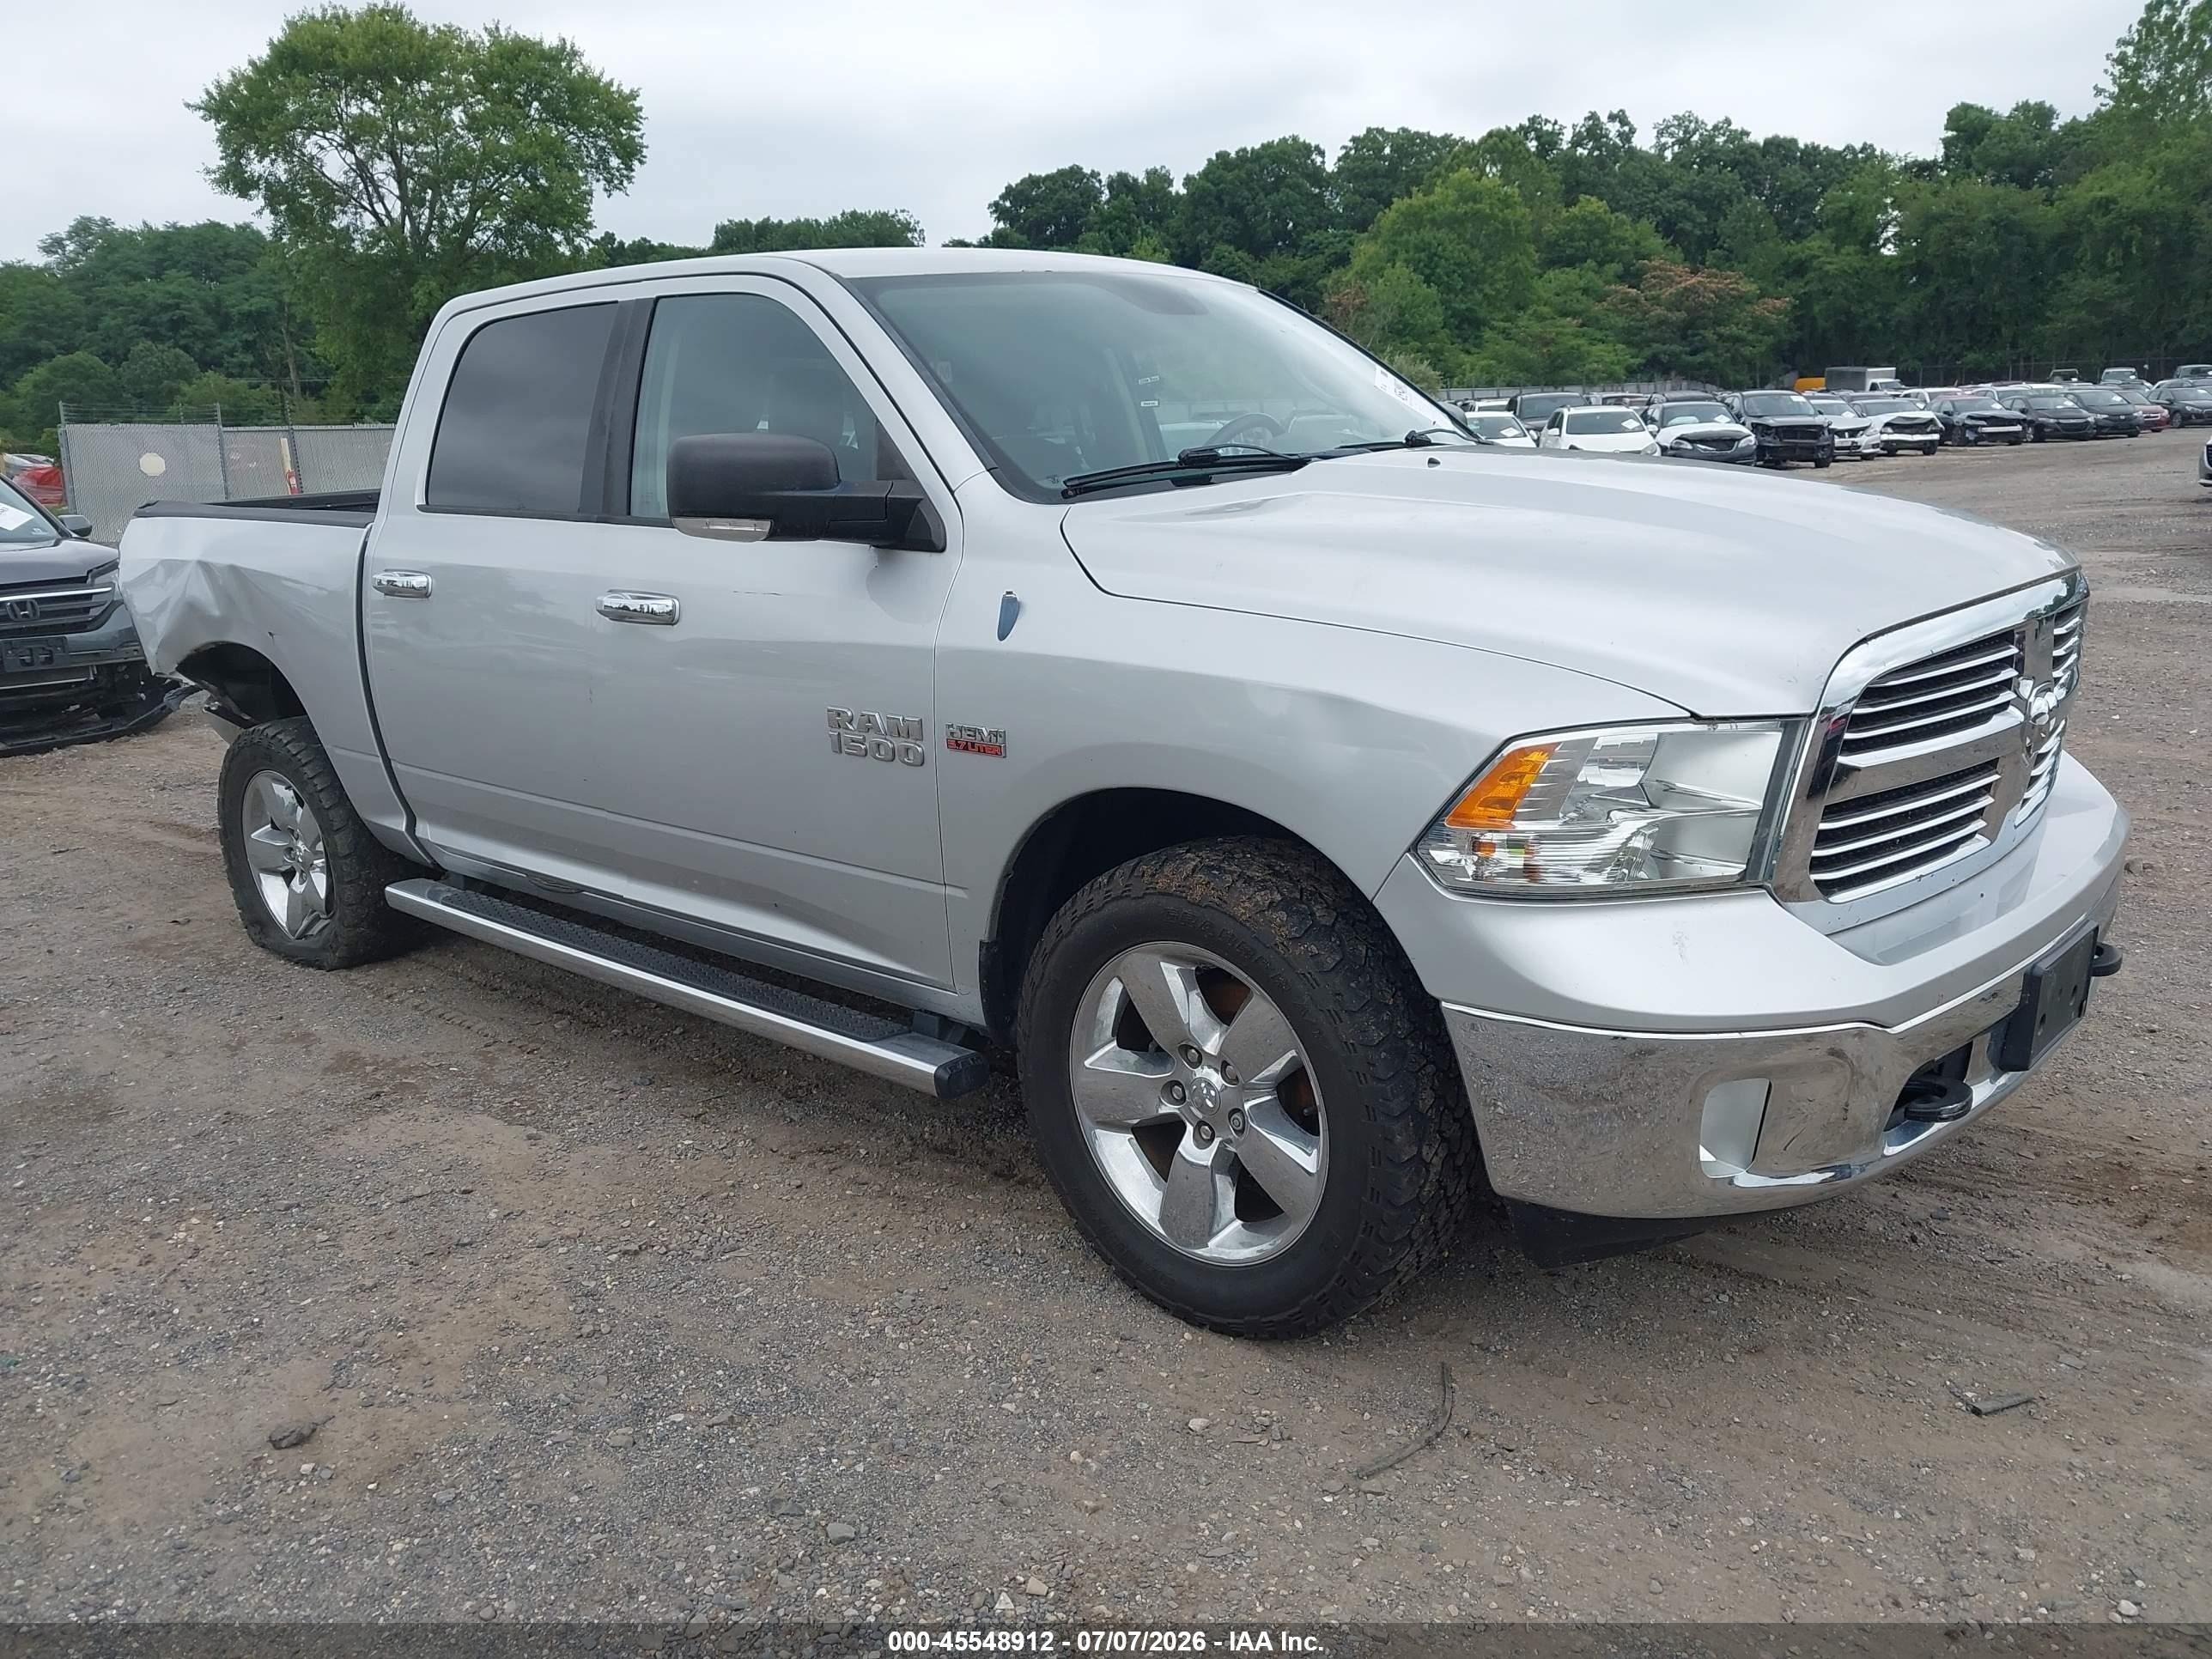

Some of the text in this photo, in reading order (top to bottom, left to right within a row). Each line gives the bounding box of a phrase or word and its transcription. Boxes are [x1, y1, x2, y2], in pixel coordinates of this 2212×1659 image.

[826, 706, 923, 741] RAM
[945, 722, 1006, 744] HEMI
[829, 730, 925, 767] 1500
[947, 738, 1002, 756] 5.7 LITER
